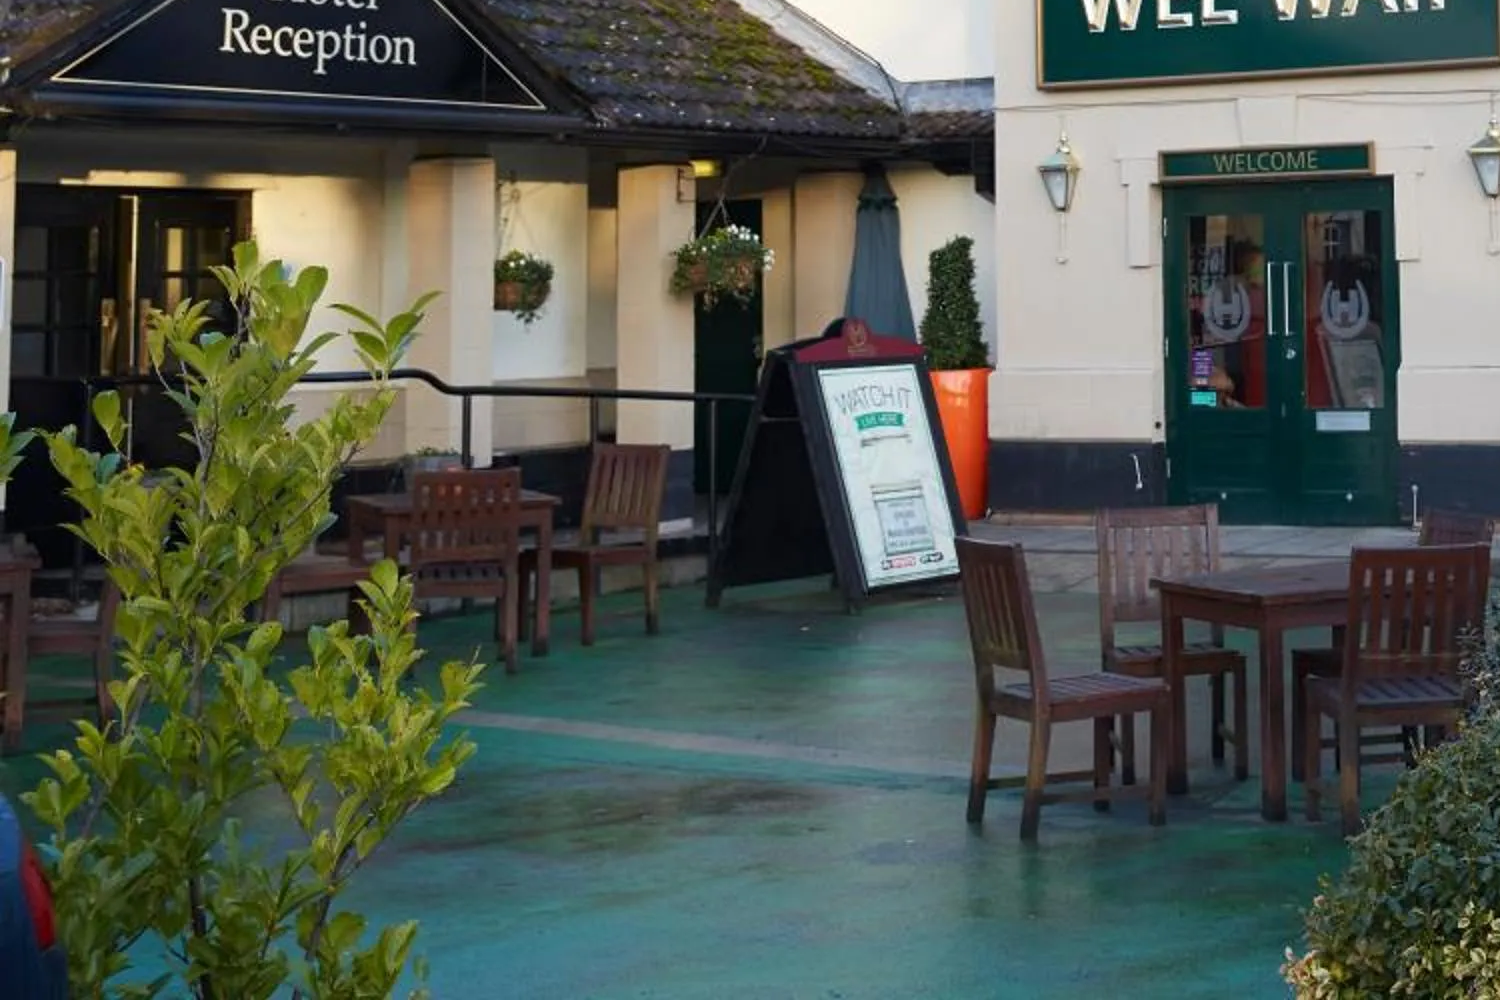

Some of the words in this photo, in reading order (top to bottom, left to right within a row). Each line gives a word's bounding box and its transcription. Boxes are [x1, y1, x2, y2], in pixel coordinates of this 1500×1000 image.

[219, 7, 417, 75] Reception
[1213, 151, 1319, 173] WELCOME
[834, 385, 895, 415] WATCH
